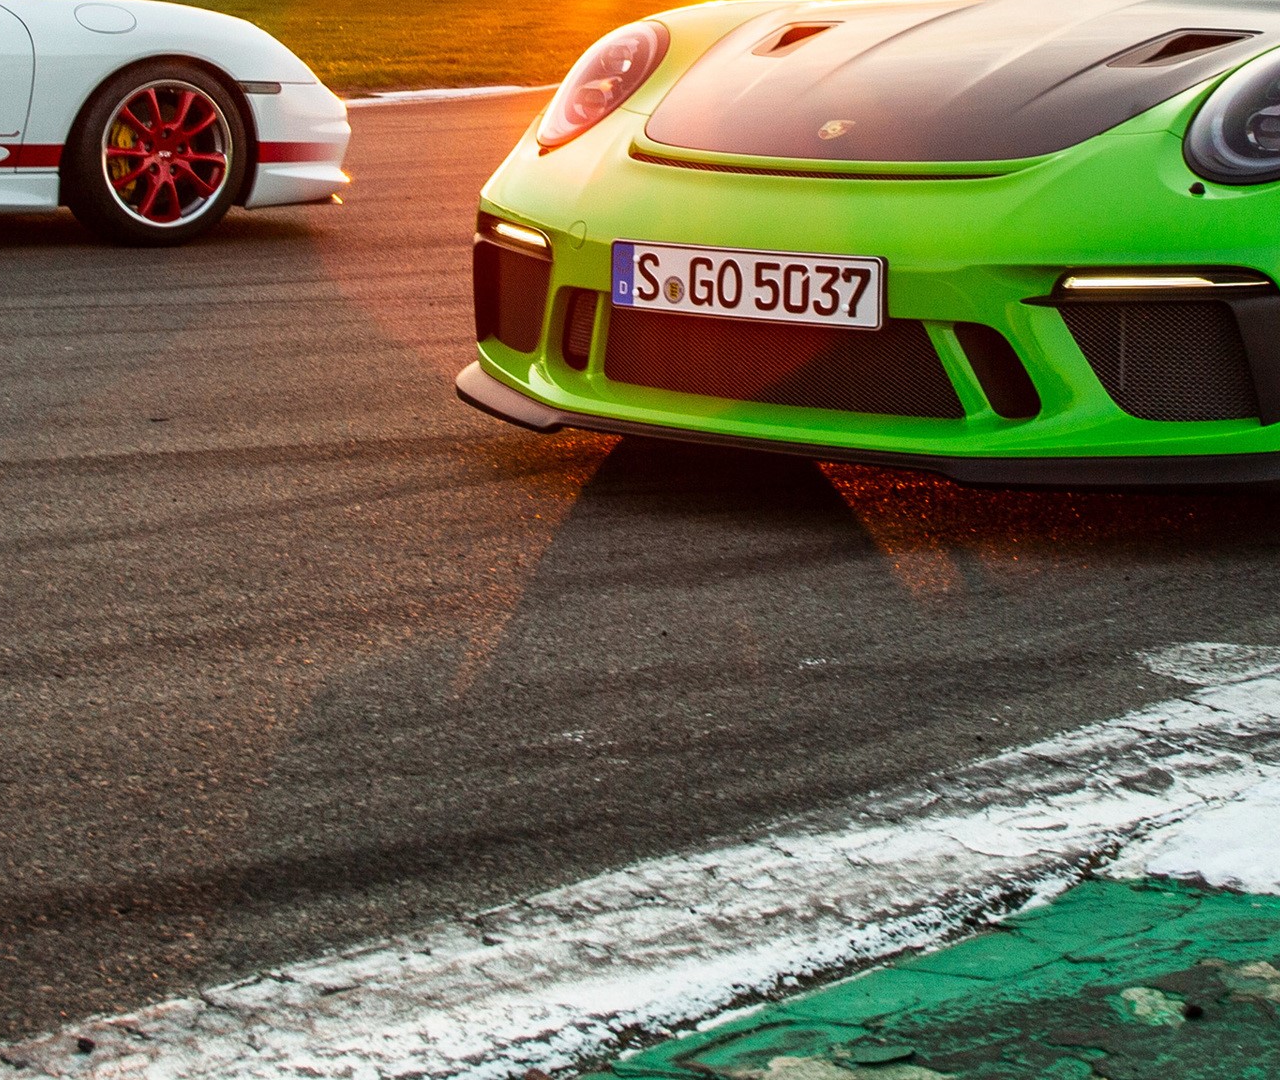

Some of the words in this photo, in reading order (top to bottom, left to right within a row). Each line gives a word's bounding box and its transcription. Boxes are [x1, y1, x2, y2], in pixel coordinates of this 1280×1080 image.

[637, 252, 660, 301] S
[688, 256, 743, 309] GO
[754, 261, 871, 318] 5037
